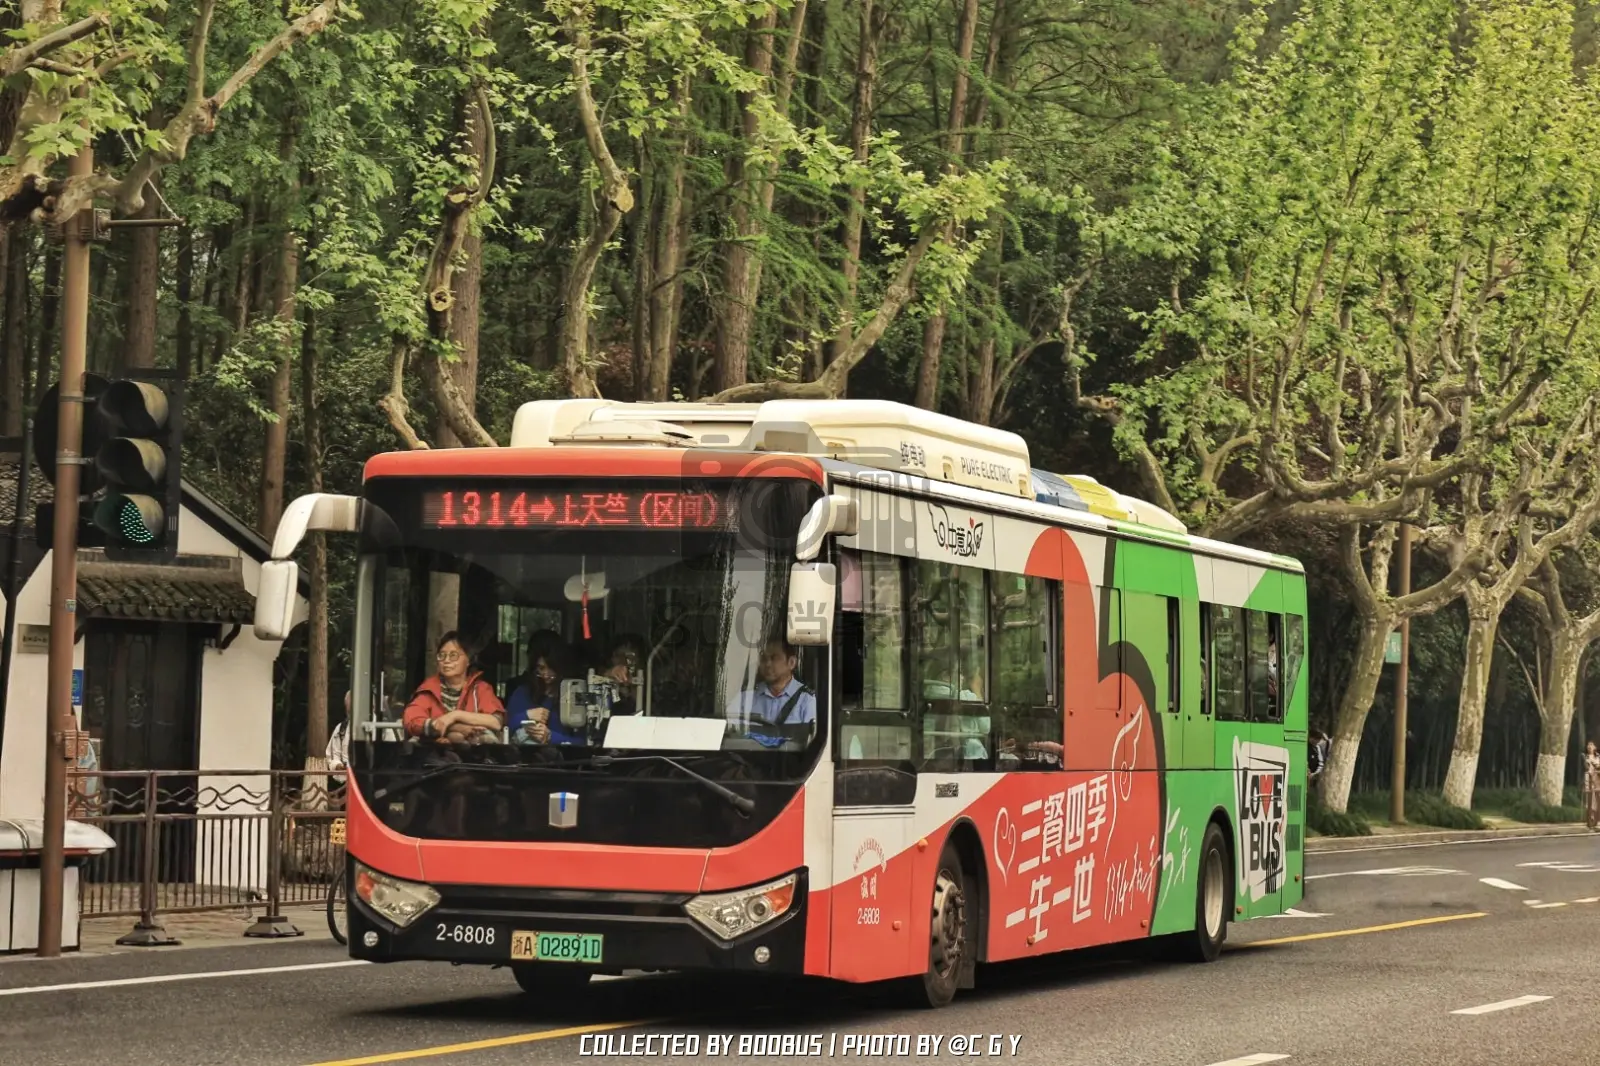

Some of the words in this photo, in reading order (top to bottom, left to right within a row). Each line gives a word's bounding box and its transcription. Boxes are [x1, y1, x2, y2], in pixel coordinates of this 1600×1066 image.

[960, 456, 981, 477] PURE
[980, 461, 1013, 484] ELECTRIC
[438, 491, 529, 526] 1314
[1240, 767, 1283, 820] LOVE
[1017, 774, 1108, 875] 三餐四季
[1250, 821, 1281, 871] BUS
[857, 907, 881, 925] 2-6808
[1005, 853, 1096, 945] 一生一世
[436, 923, 496, 945] 2-6808
